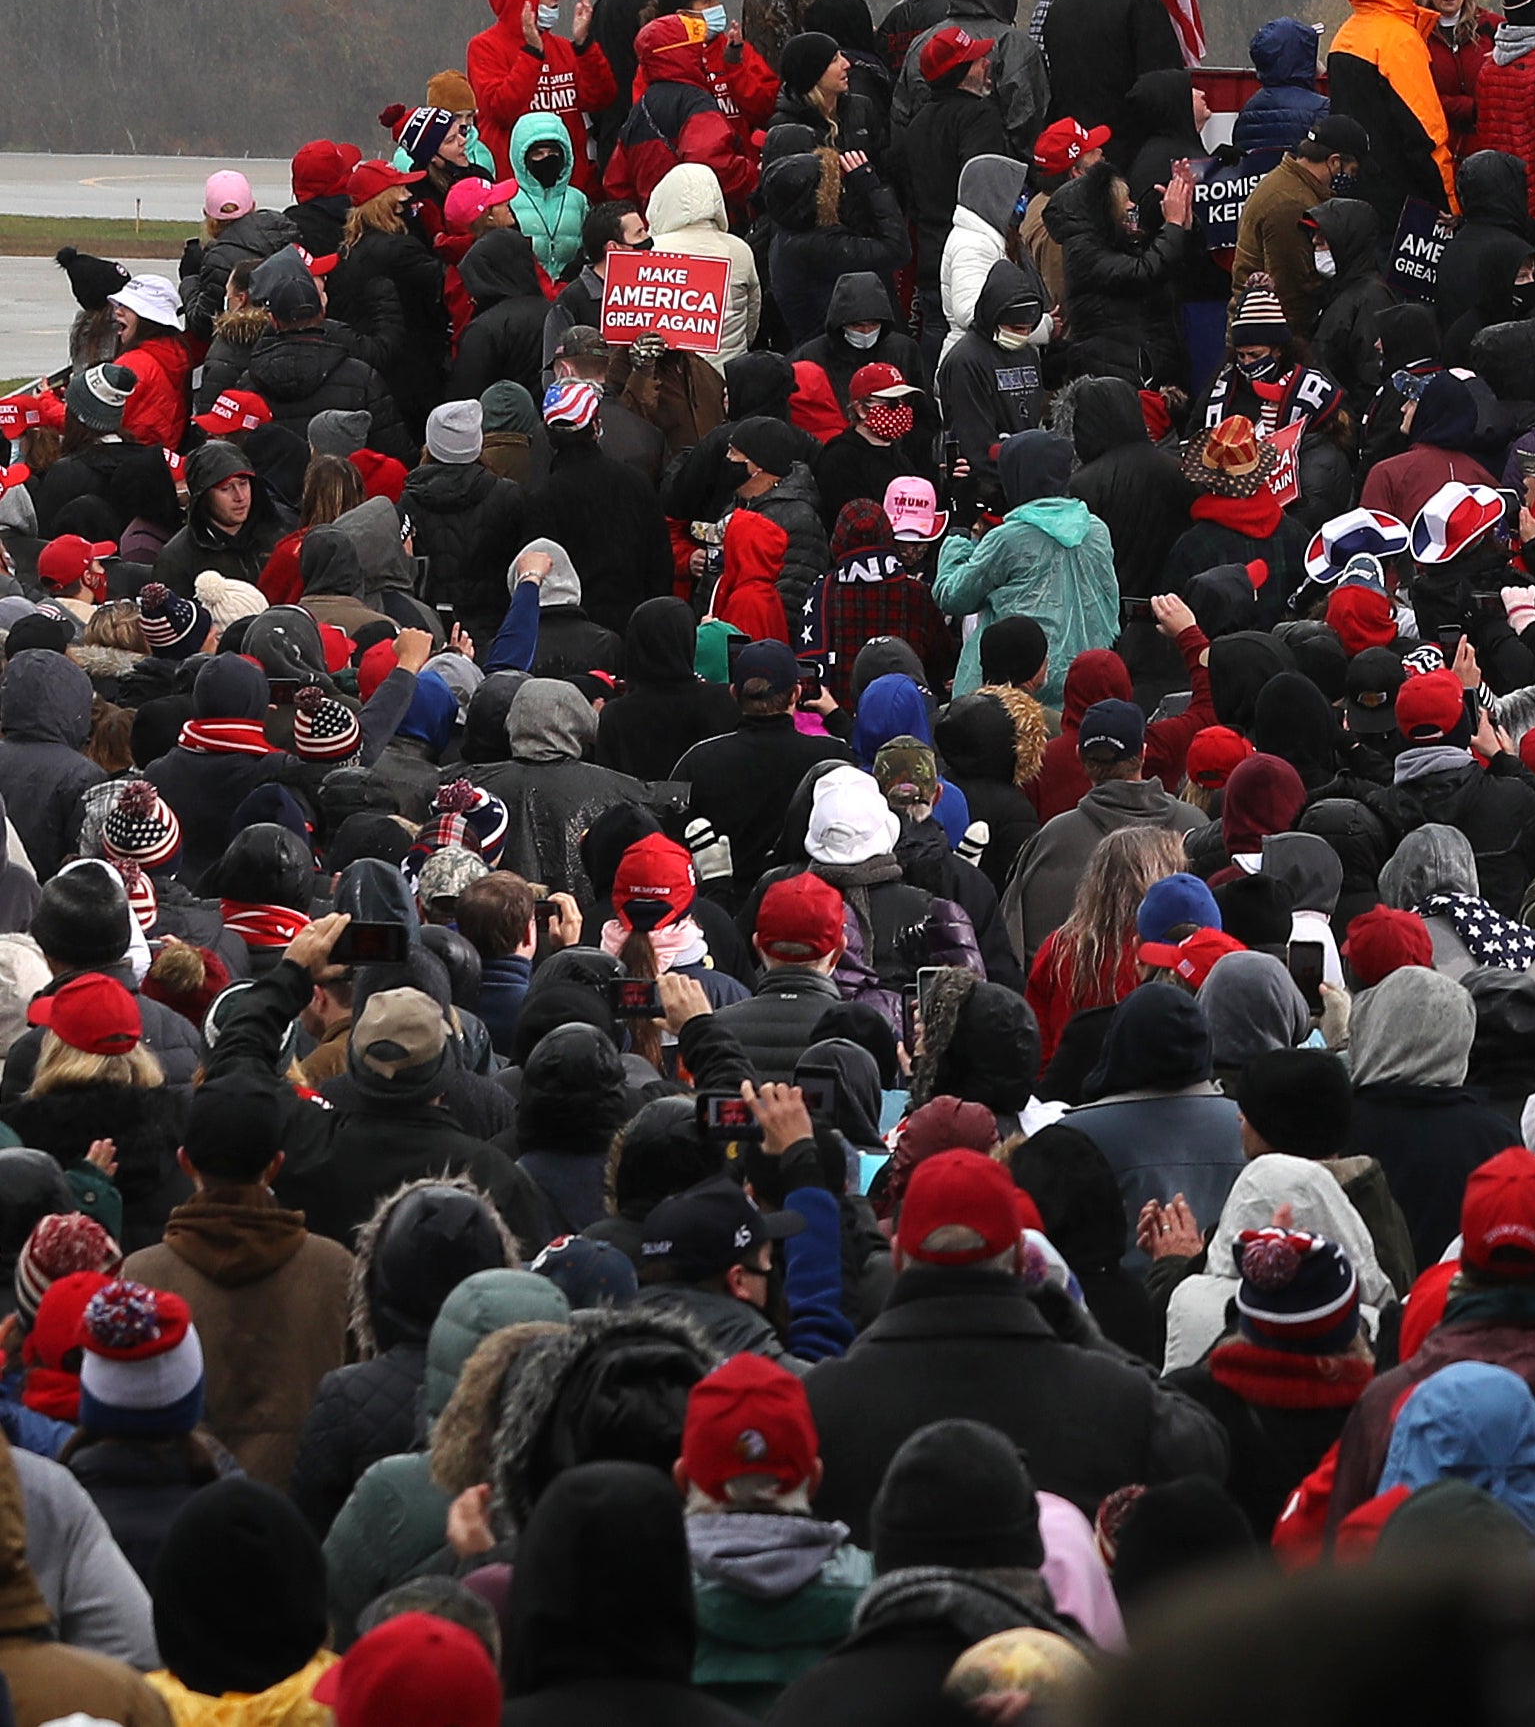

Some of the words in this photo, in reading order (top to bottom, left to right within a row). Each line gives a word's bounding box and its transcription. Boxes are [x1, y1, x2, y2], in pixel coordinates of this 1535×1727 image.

[530, 88, 577, 111] RUMP
[1195, 174, 1268, 202] ROMIS
[1432, 224, 1454, 241] MA
[637, 266, 688, 284] MAKE
[607, 285, 718, 314] AMERICA
[605, 311, 654, 327] GREAT
[656, 314, 717, 334] AGAIN
[1272, 471, 1293, 495] AIN
[894, 496, 930, 509] TRUMP
